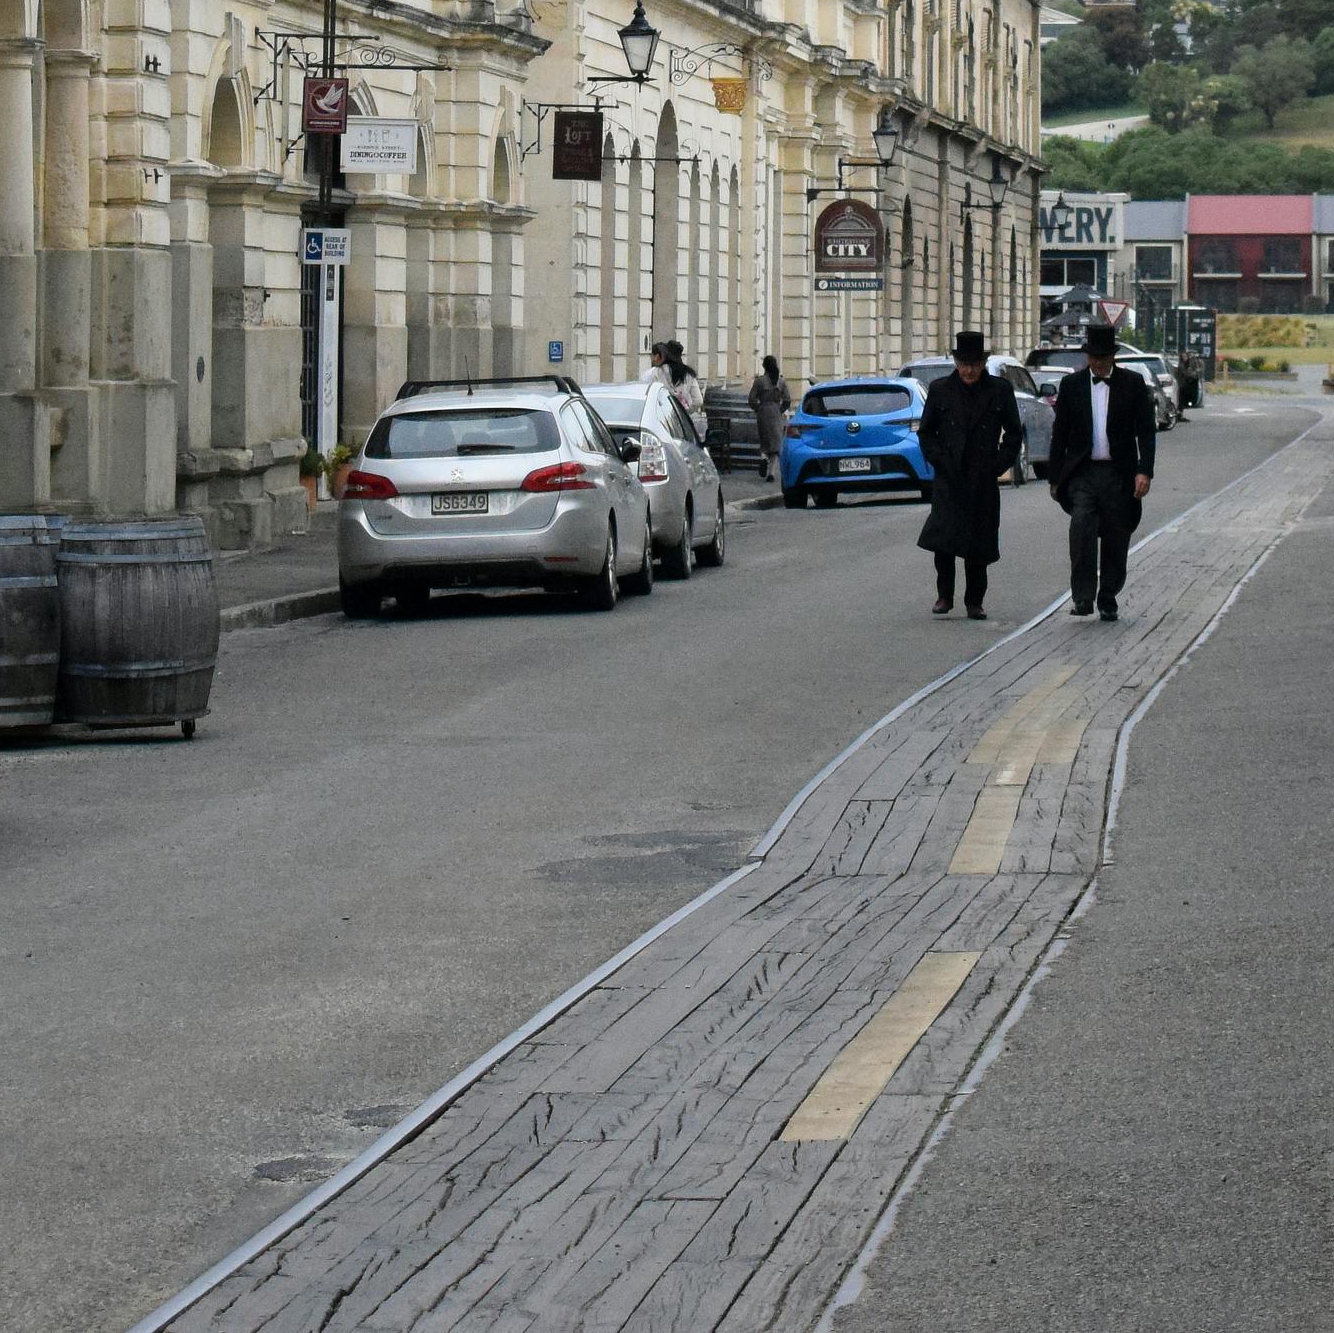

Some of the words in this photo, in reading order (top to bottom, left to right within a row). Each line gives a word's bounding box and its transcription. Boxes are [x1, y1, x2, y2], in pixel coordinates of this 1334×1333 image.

[826, 244, 871, 257] CITY
[829, 280, 879, 288] INFORMATION
[433, 493, 487, 511] JSG349
